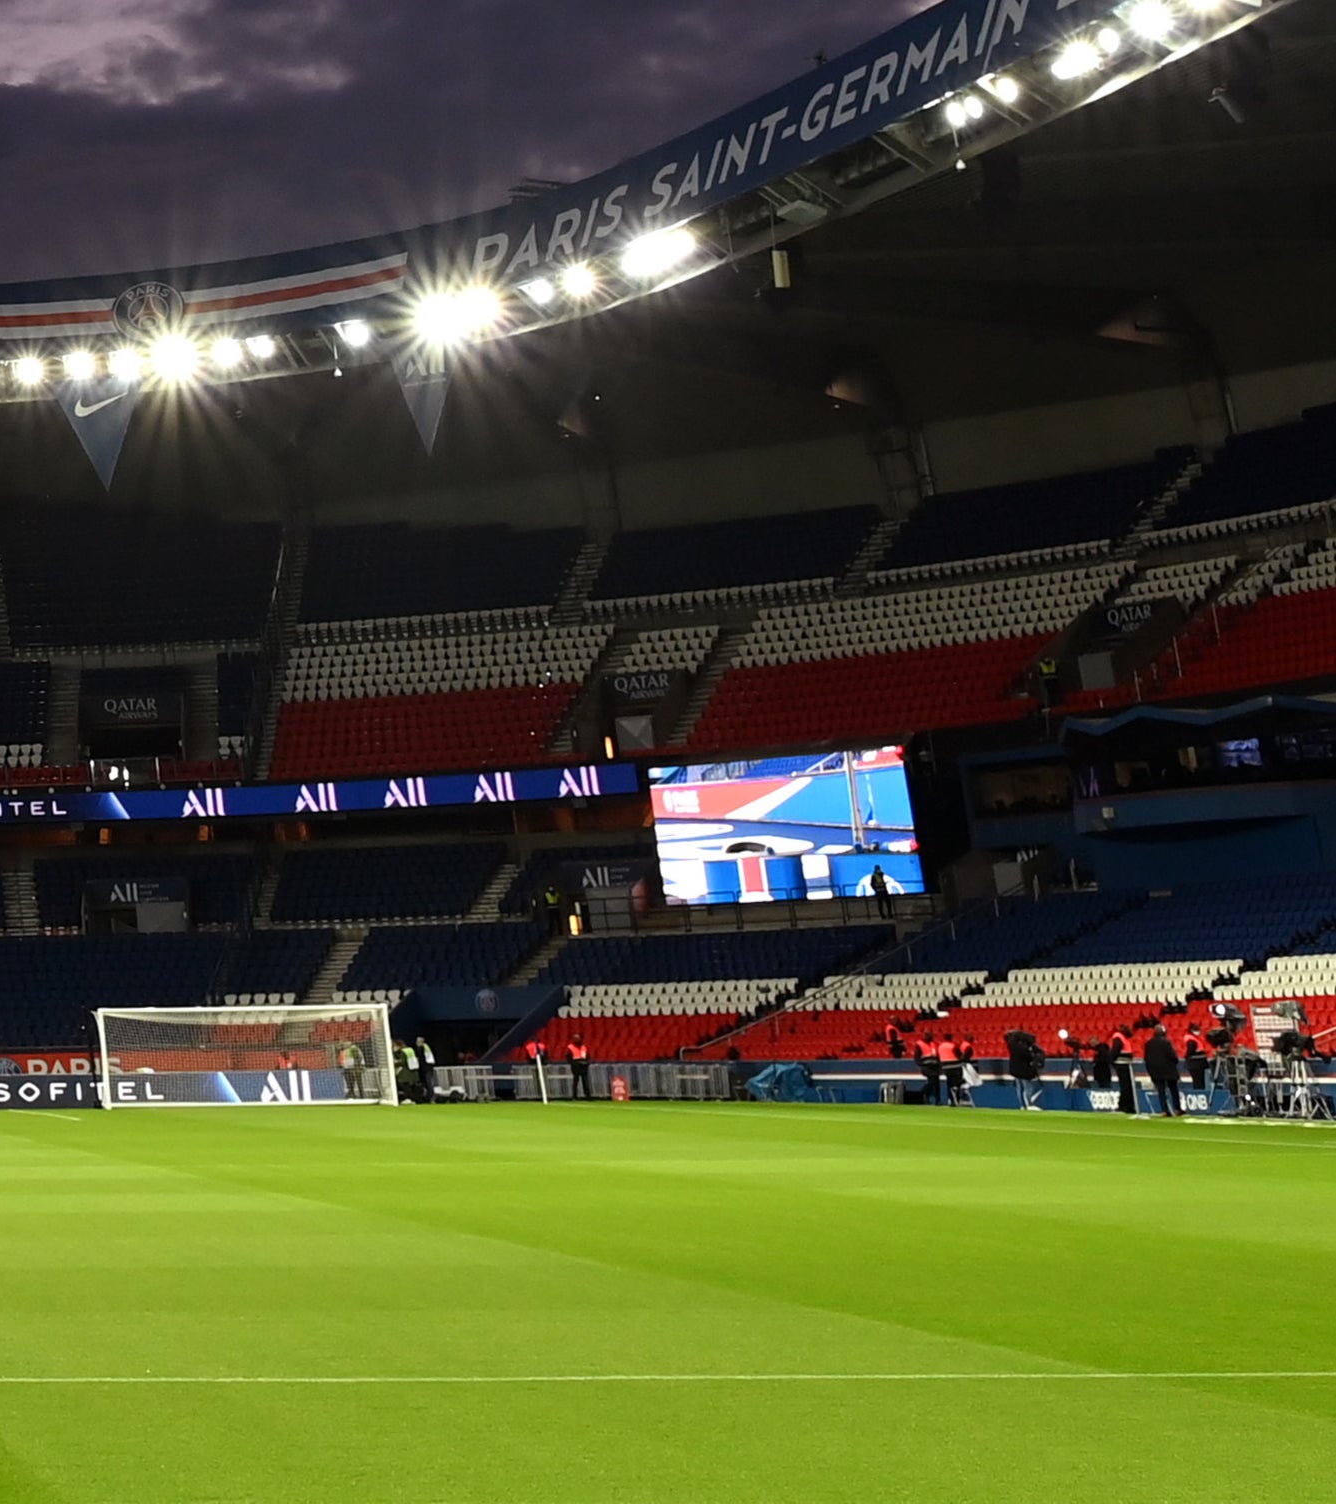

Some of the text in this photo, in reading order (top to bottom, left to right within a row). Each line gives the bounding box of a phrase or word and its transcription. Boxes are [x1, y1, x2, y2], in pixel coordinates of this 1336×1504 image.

[471, 184, 629, 274] PARIS
[126, 287, 170, 302] PARIS
[1107, 604, 1151, 628] QATAR
[614, 674, 669, 694] QATAR
[103, 698, 157, 714] QATAR
[1187, 1094, 1208, 1110] QNB
